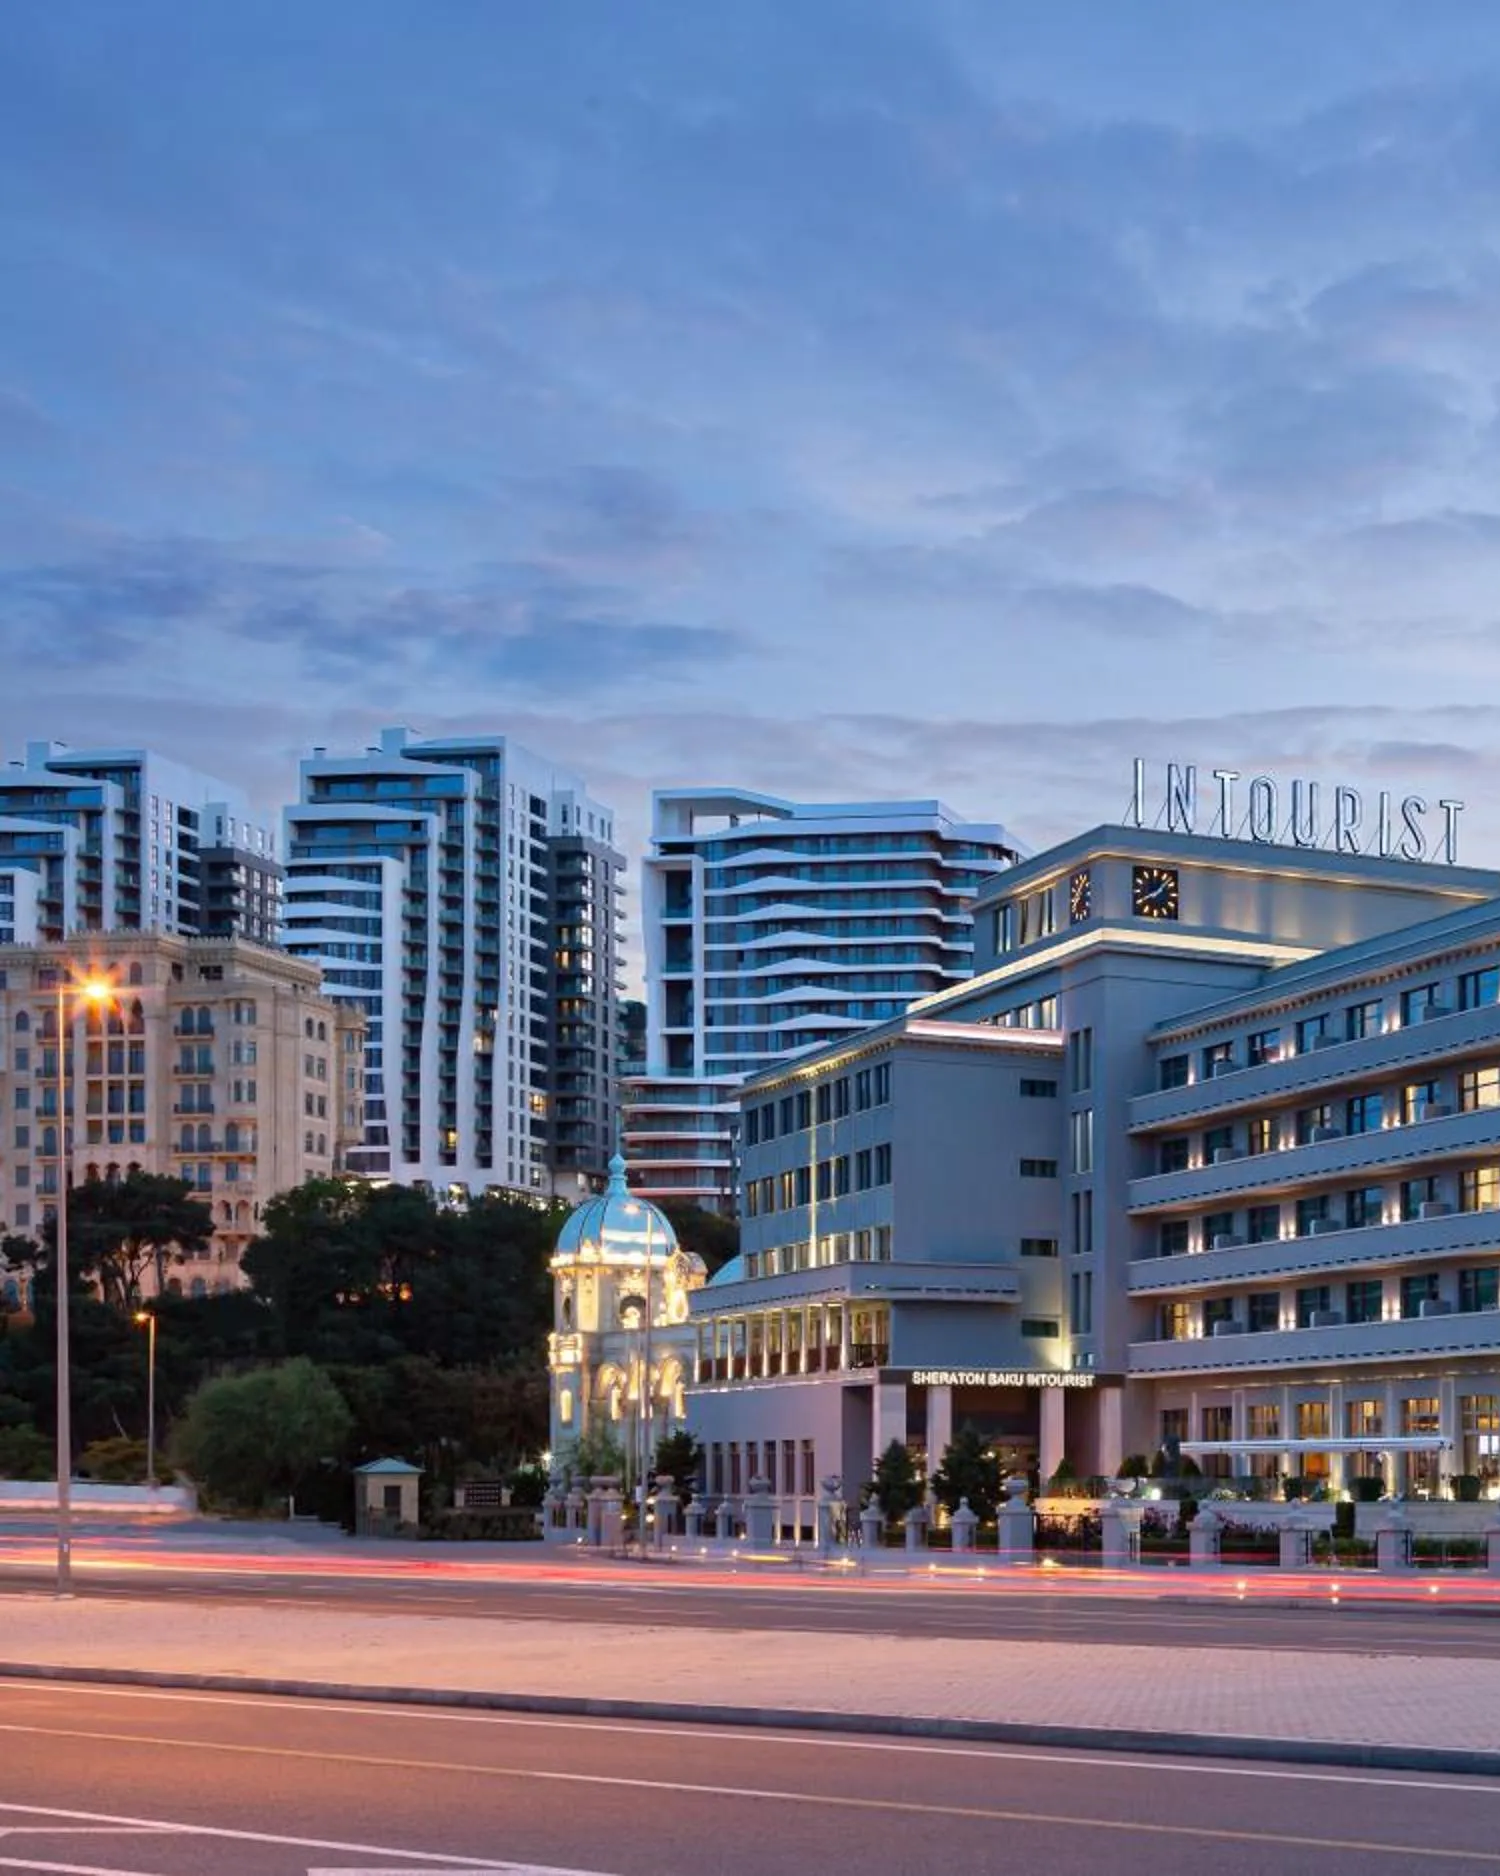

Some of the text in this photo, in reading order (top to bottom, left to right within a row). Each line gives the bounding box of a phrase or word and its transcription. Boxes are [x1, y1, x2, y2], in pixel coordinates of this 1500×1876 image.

[1133, 757, 1465, 864] INTOURIST
[912, 1371, 1095, 1389] SHERATON BAKU INTOURIST
